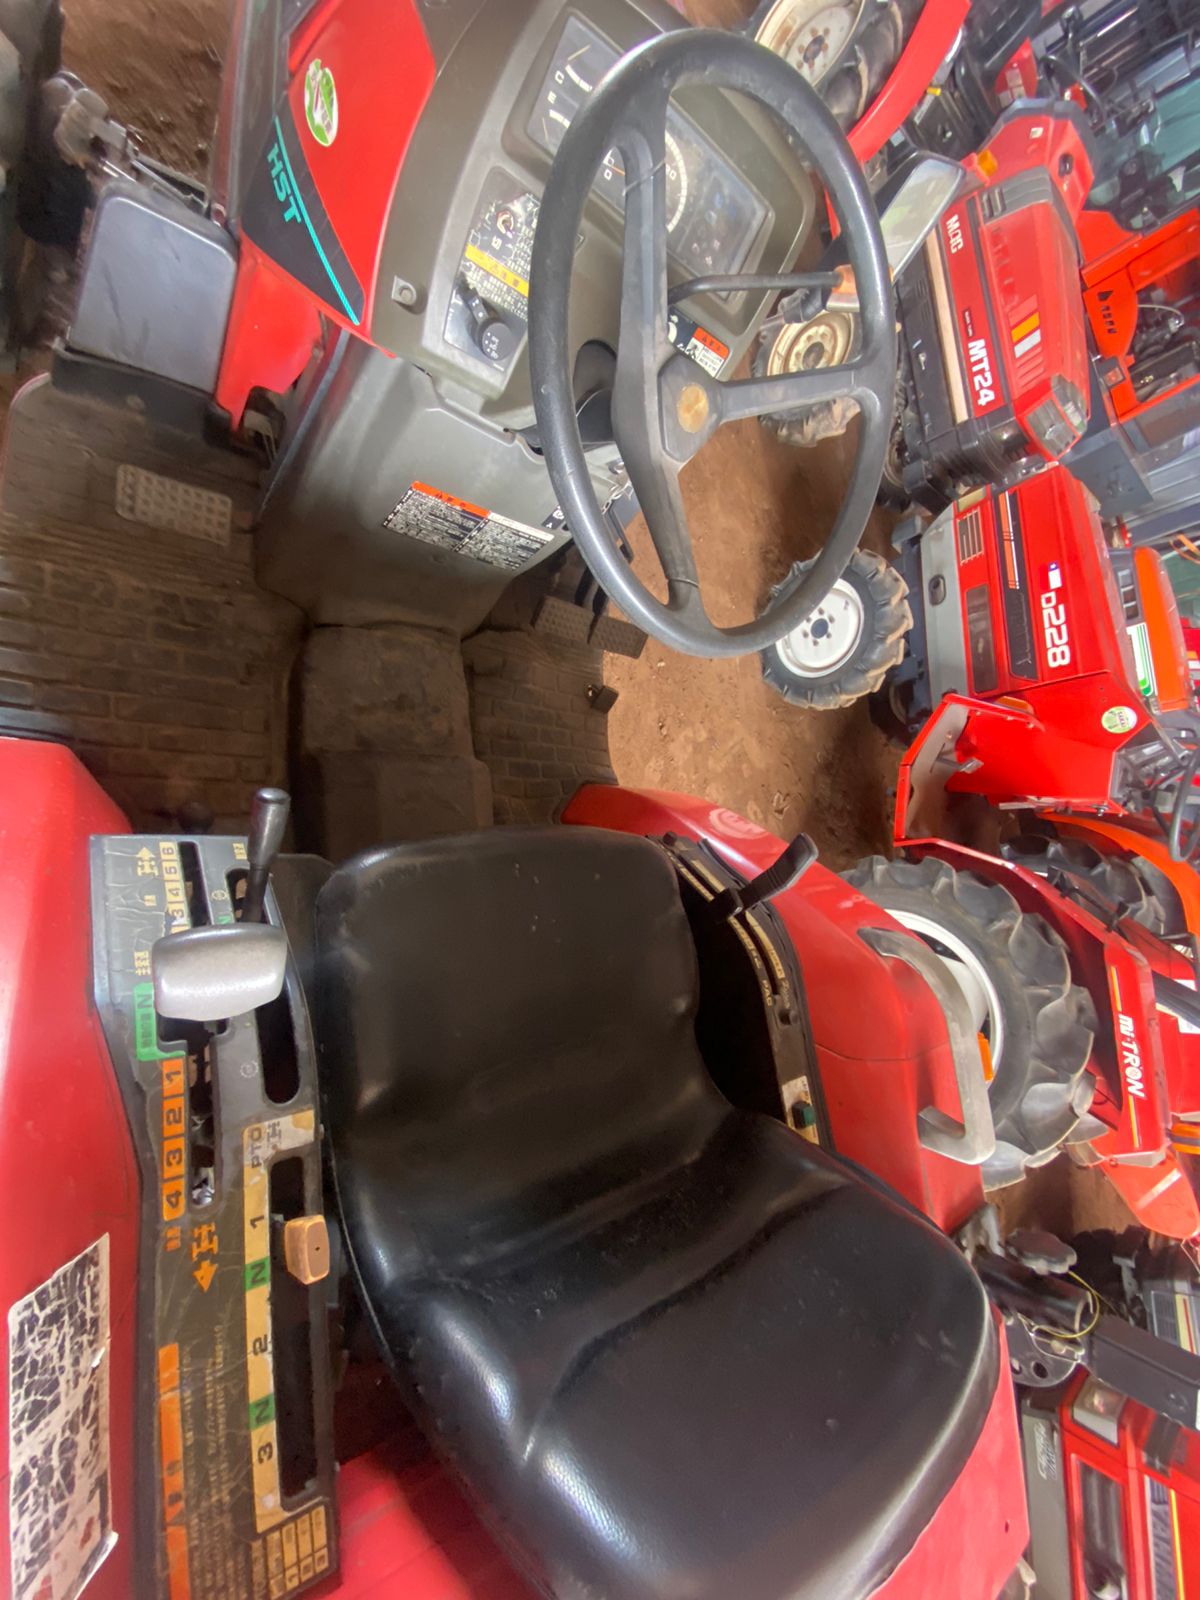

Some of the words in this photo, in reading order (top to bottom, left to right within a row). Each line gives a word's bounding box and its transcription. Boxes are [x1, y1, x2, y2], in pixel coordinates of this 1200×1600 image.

[267, 143, 302, 223] HST
[968, 338, 996, 406] MT24
[1040, 591, 1071, 668] D228
[162, 847, 175, 856] 6
[165, 865, 178, 875] 5
[168, 887, 181, 897] 4
[137, 994, 153, 1008] N
[165, 1068, 182, 1084] 1
[165, 1106, 183, 1125] 2
[165, 1147, 183, 1168] 3
[249, 1126, 263, 1169] PTO
[165, 1188, 183, 1209] 4
[250, 1214, 265, 1230] 1
[250, 1262, 266, 1283] N
[252, 1333, 269, 1356] 2
[255, 1400, 271, 1423] N
[257, 1441, 273, 1464] 3
